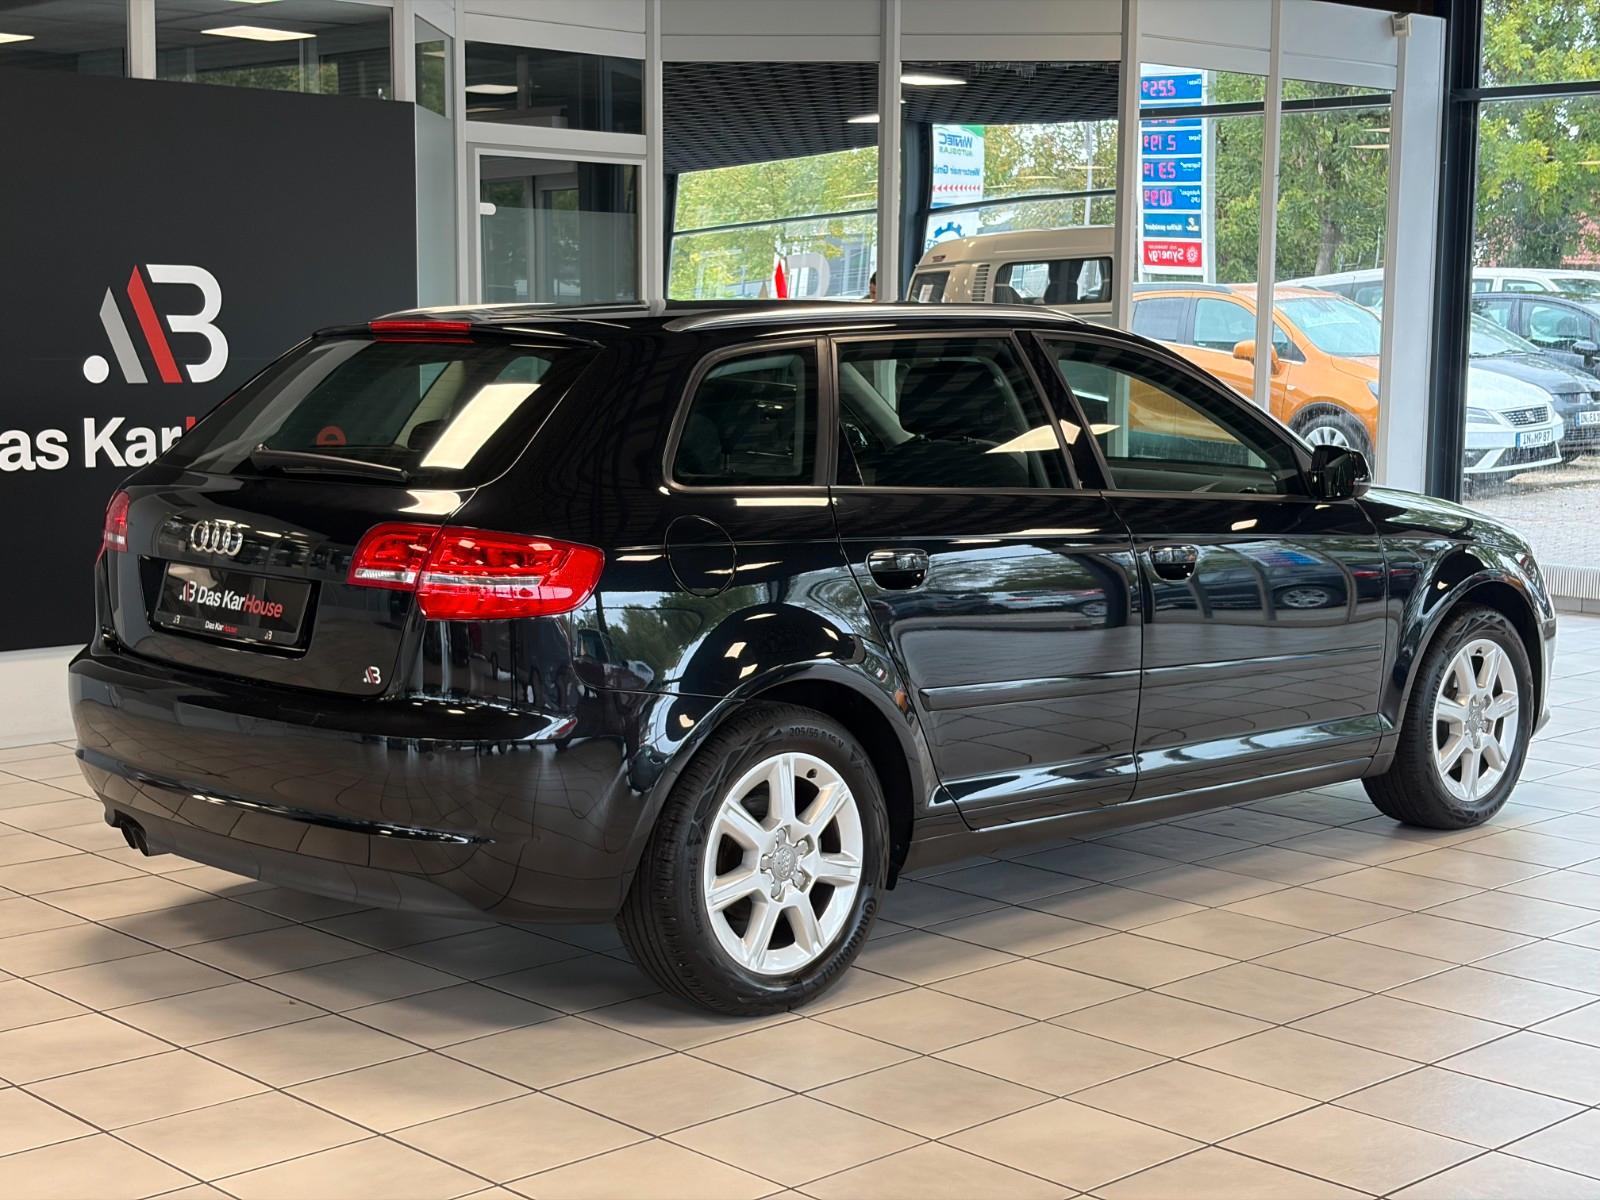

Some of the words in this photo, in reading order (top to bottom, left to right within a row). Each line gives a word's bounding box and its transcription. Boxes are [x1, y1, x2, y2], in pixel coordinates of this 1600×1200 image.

[0, 427, 69, 472] as
[197, 585, 221, 606] Das
[204, 620, 215, 630] Das
[789, 726, 819, 738] 205/55
[823, 897, 878, 979] Continental
